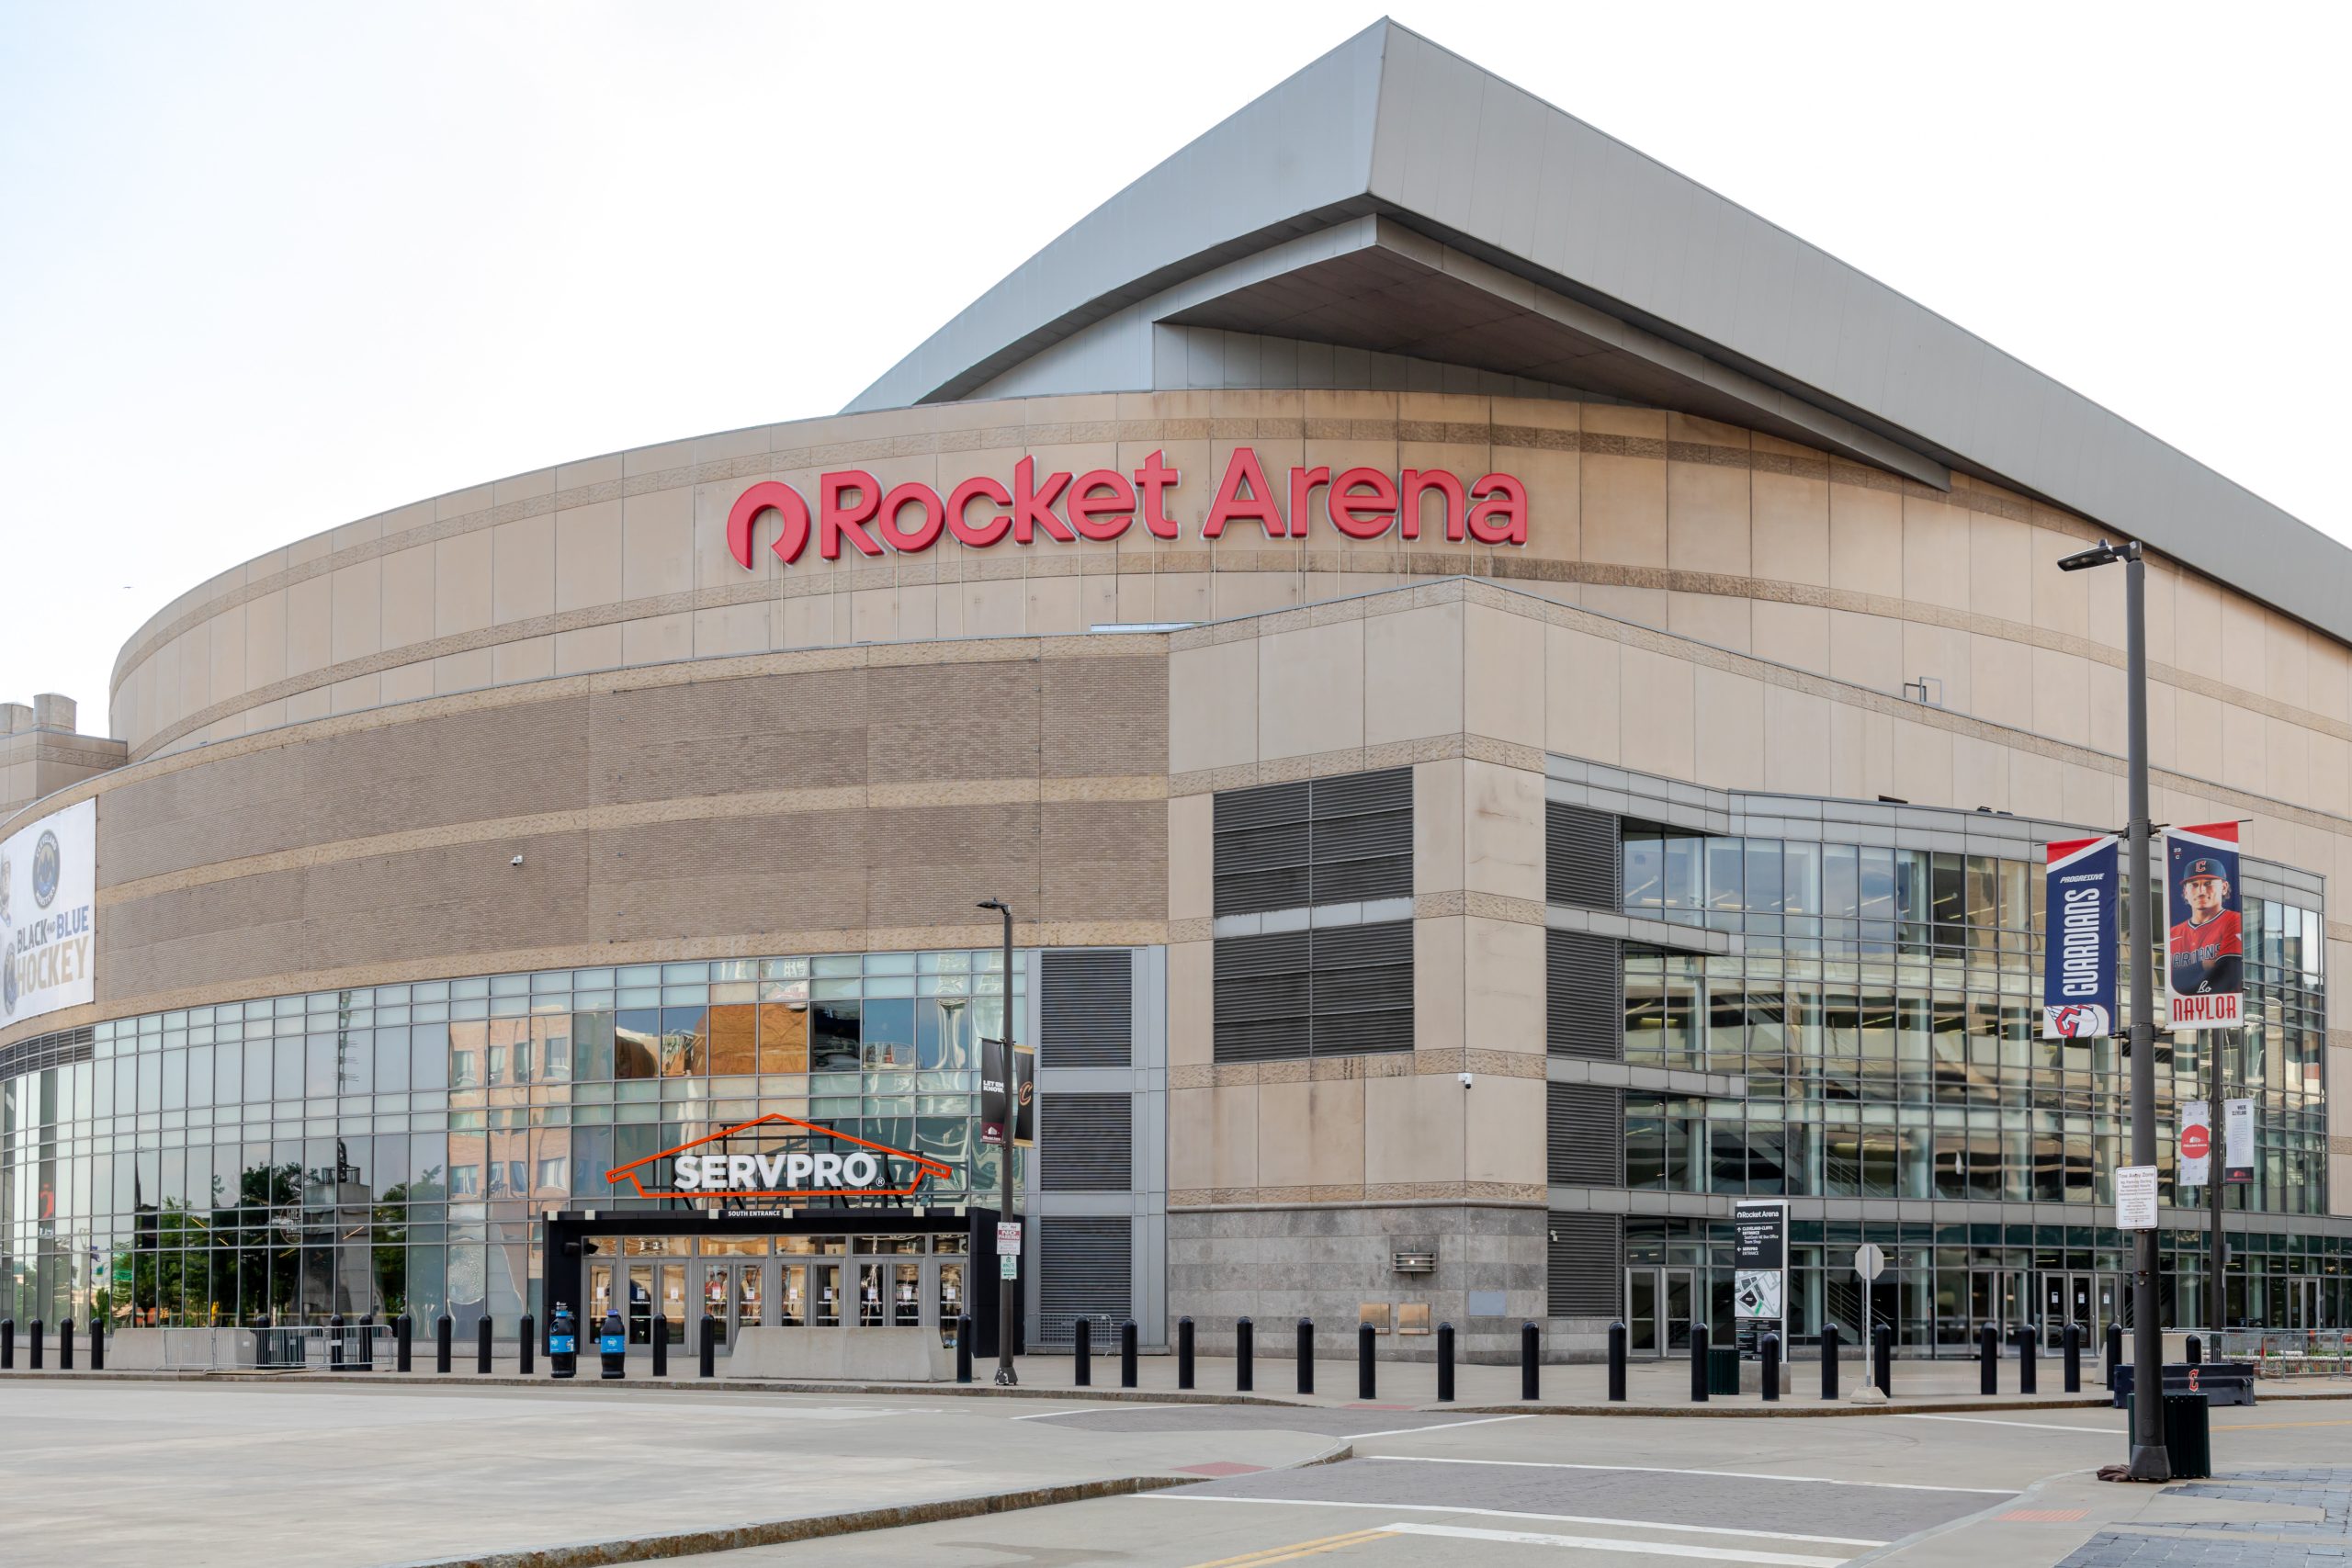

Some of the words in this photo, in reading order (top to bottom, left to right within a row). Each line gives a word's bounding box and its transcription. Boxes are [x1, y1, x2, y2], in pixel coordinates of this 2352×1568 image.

[820, 448, 1182, 562] Rocket
[1201, 447, 1529, 547] Arena
[2060, 873, 2105, 884] PROGRESSIVE
[17, 919, 47, 953] BLACK
[56, 905, 89, 940] BLUE
[2063, 887, 2100, 997] GUARDIANS
[17, 935, 90, 998] HOCKEY
[2173, 995, 2236, 1021] NAYLOR
[1019, 1081, 1033, 1106] C
[673, 1152, 877, 1189] SERVPRO
